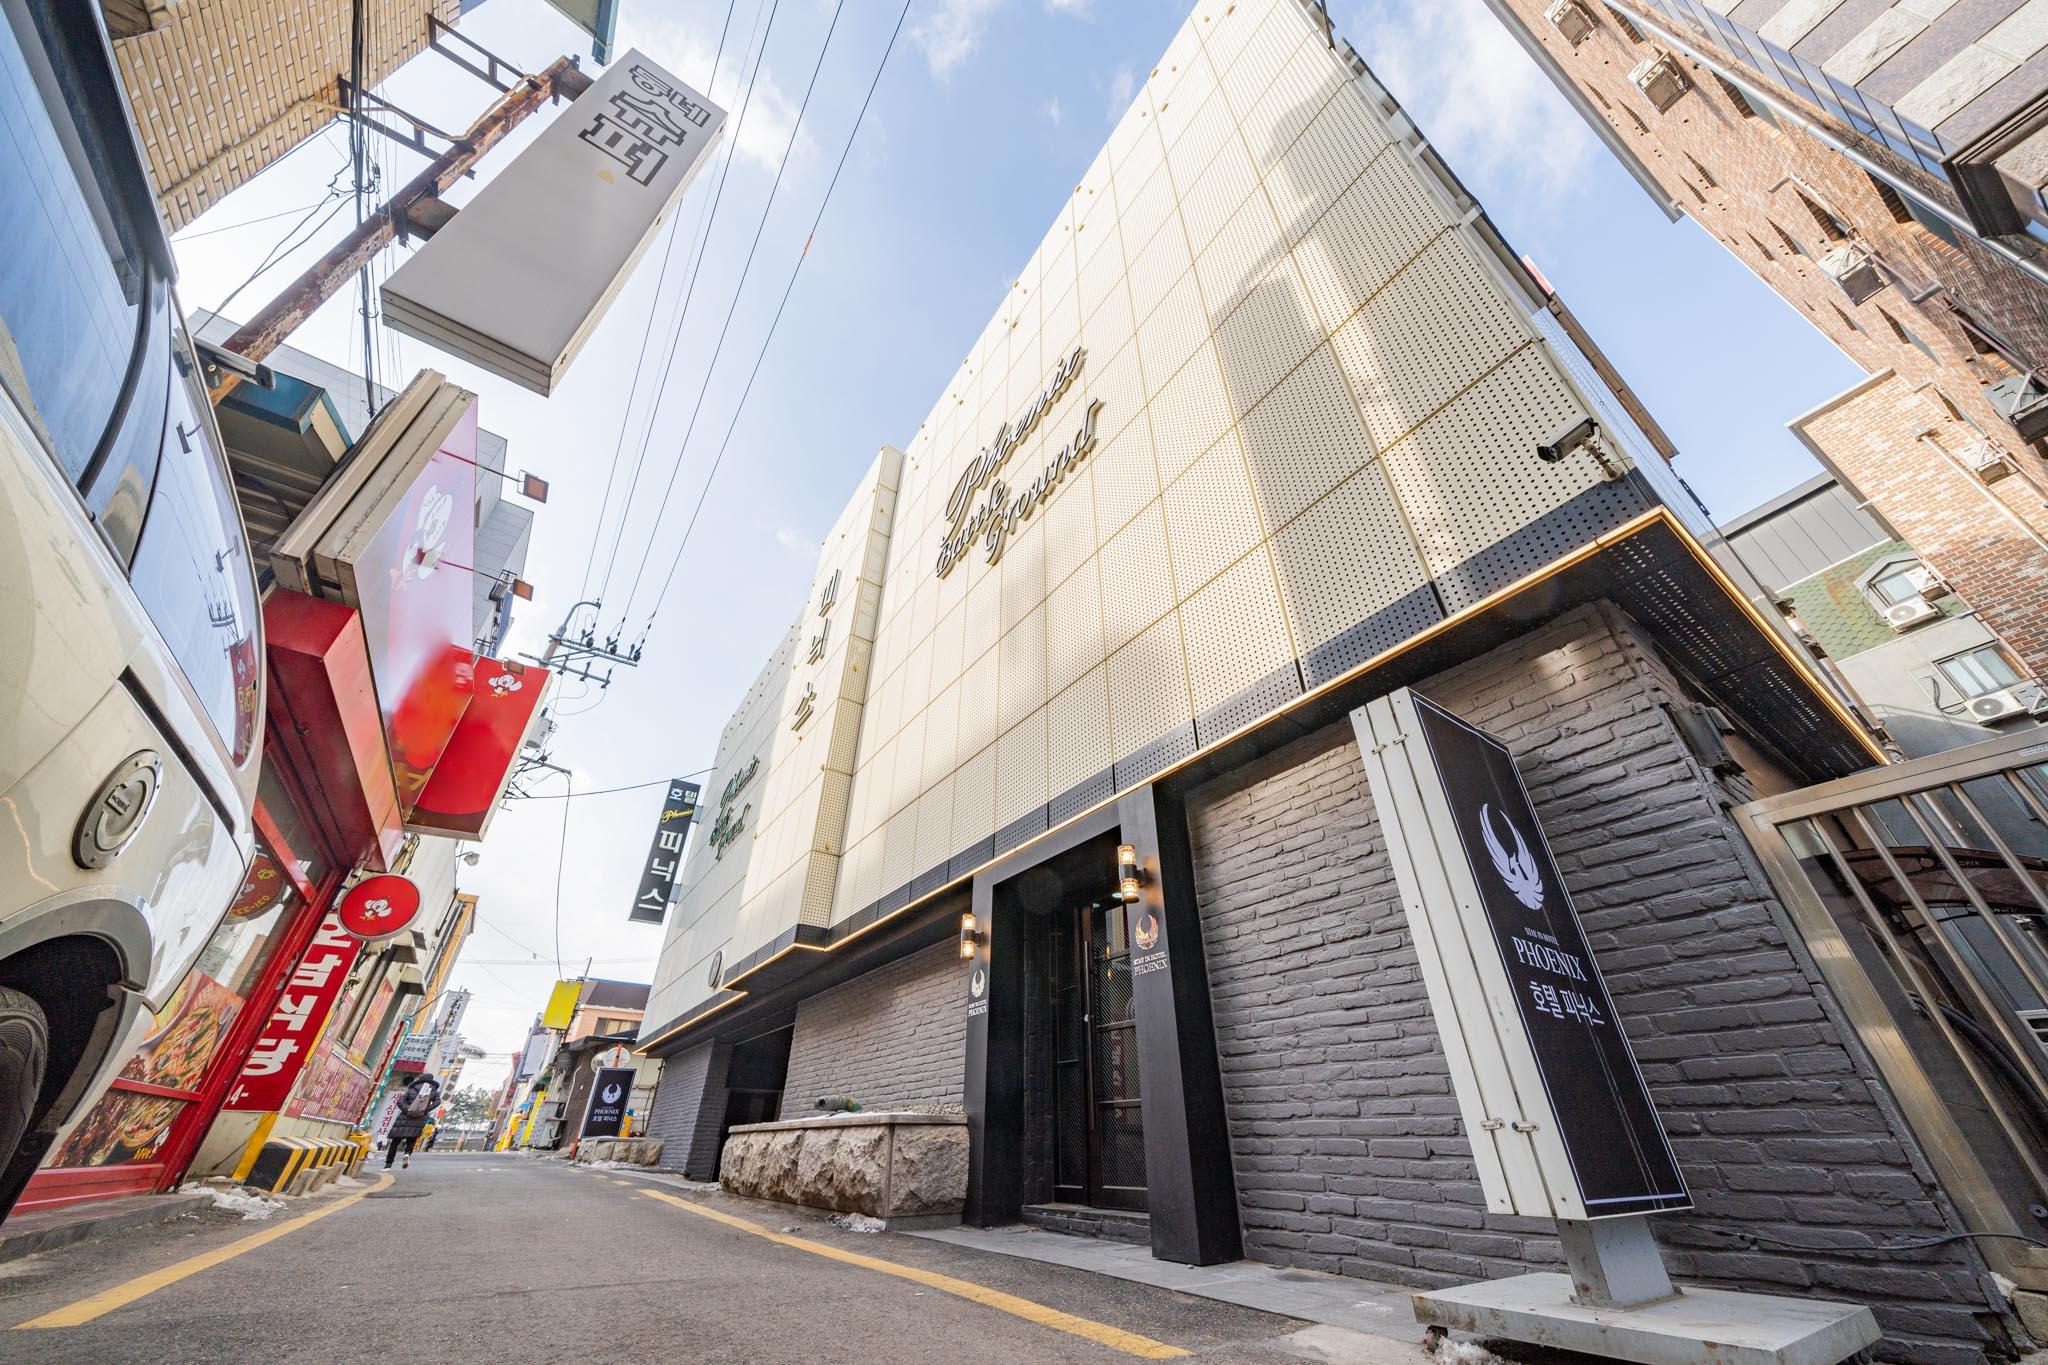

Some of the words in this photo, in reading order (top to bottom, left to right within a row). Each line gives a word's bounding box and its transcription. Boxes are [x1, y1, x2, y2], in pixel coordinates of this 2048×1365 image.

[628, 64, 711, 128] 동네
[940, 346, 1088, 548] Phoenix
[985, 397, 1106, 567] Ground
[669, 787, 697, 804] 호텔
[638, 830, 683, 911] 피닉스
[1134, 958, 1168, 976] PHOENIX
[1512, 936, 1588, 982] PHOENIX
[1529, 980, 1564, 1019] 호텔
[1560, 990, 1605, 1026] 피닉스
